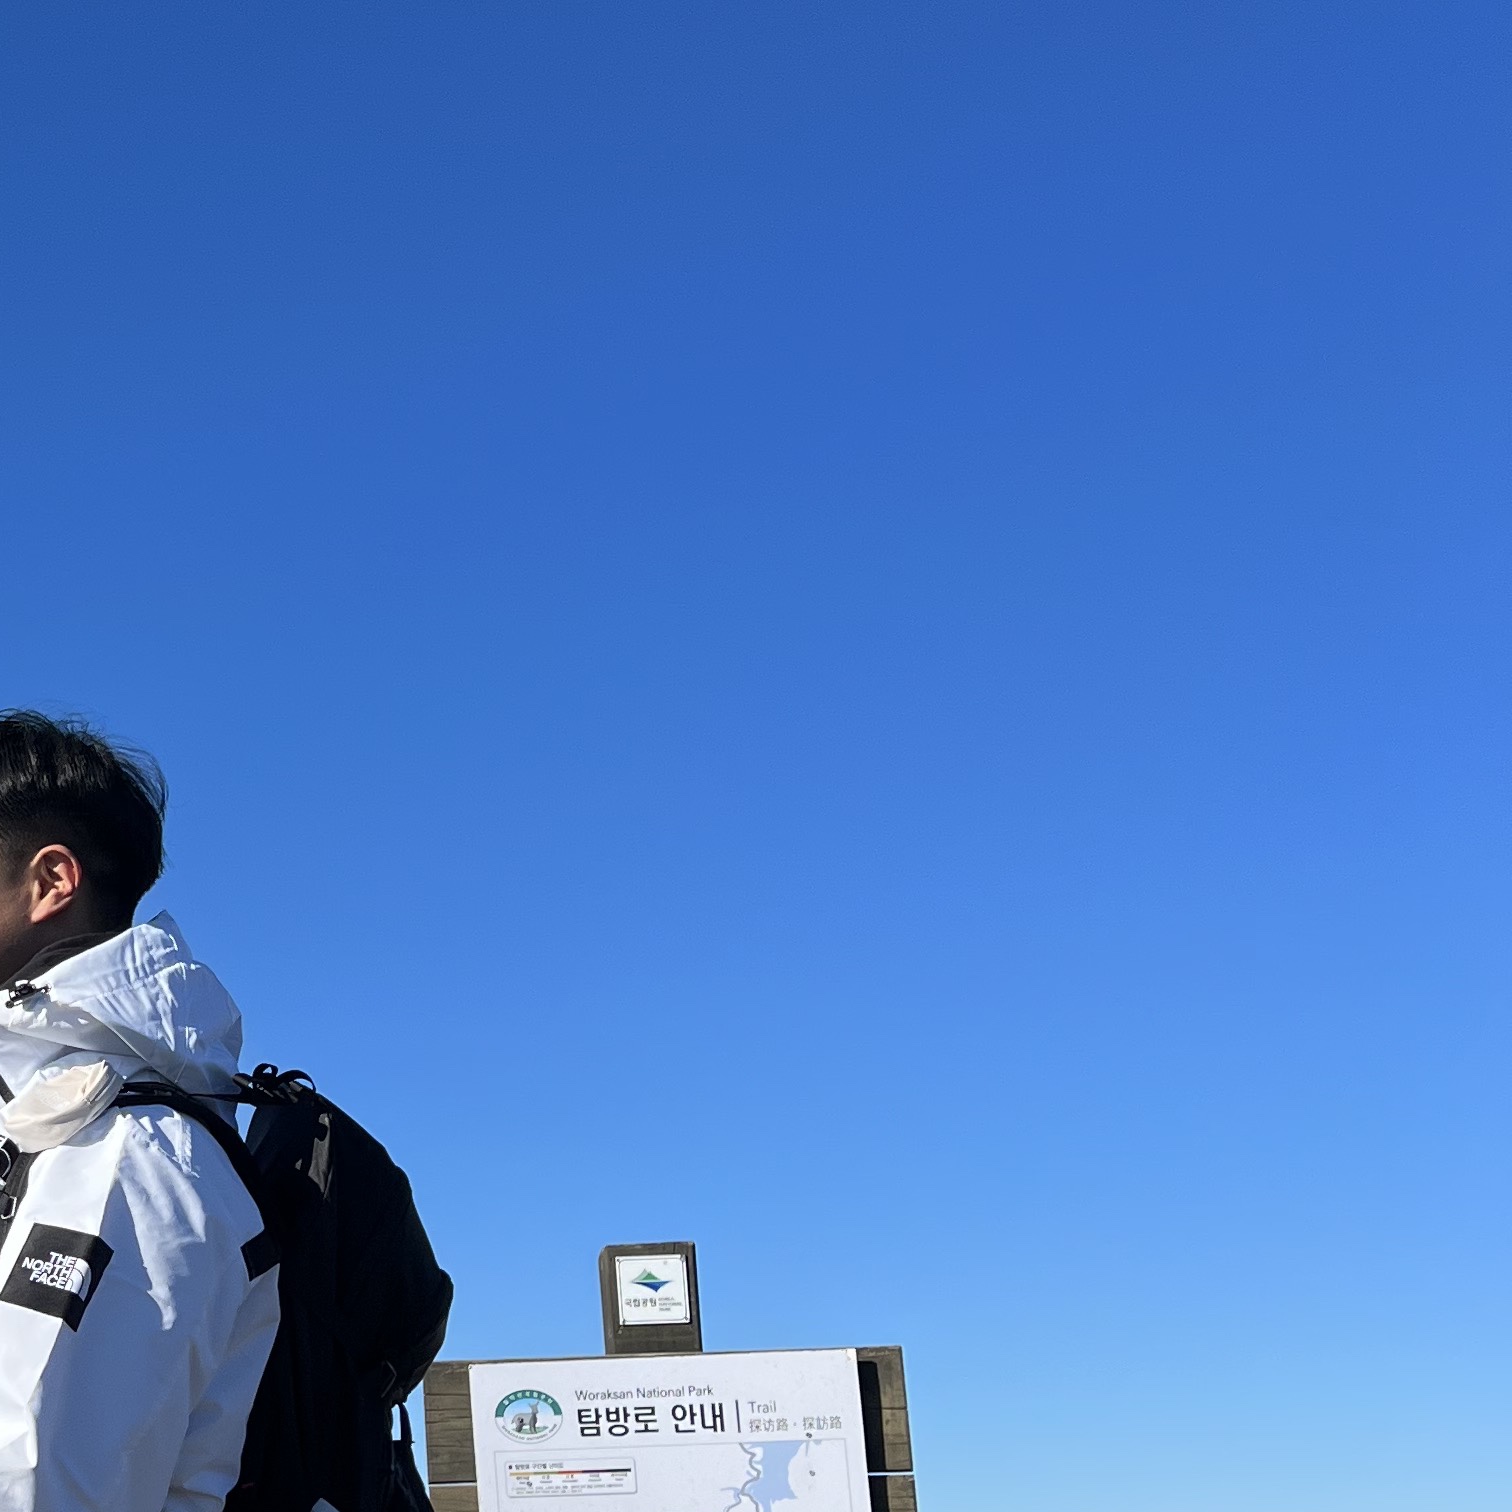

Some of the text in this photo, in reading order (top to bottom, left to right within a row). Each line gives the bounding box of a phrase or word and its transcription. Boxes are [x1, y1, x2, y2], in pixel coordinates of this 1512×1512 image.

[21, 1256, 73, 1279] NORTH
[49, 1251, 78, 1268] THE
[29, 1270, 69, 1291] FACE
[574, 1384, 714, 1401] Woraksan National Park
[748, 1400, 777, 1414] Trail
[577, 1405, 659, 1437] 탐방로
[671, 1402, 725, 1433] 안내
